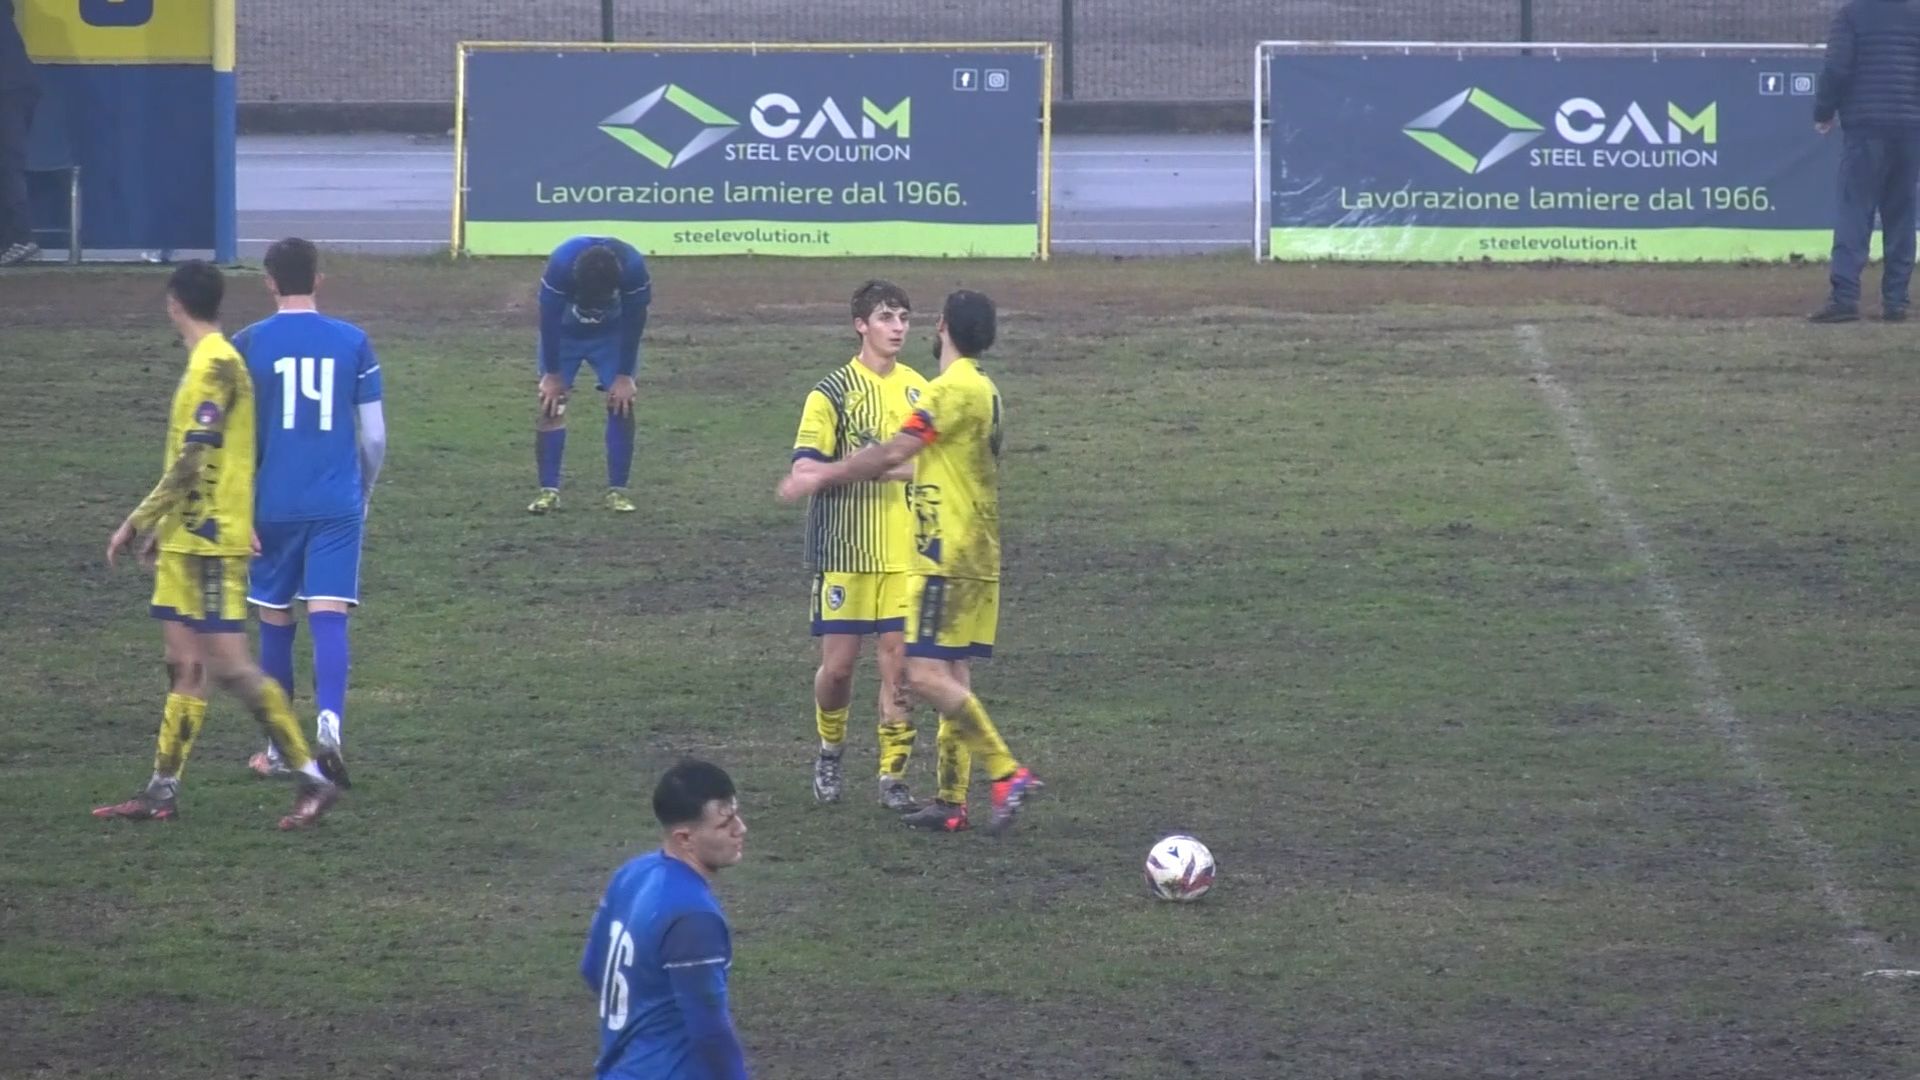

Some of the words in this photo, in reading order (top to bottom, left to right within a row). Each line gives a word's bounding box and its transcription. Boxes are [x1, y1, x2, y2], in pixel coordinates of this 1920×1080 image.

[750, 92, 911, 139] CAM
[1555, 97, 1718, 144] CAM
[725, 143, 780, 161] STEEL
[788, 143, 911, 162] EVOLUTION
[1530, 148, 1586, 167] STEEL
[1594, 148, 1718, 168] EVOLUTION
[536, 181, 714, 204] Lavorazione
[724, 181, 833, 204] lamiere
[843, 181, 886, 204] dal
[894, 181, 967, 206] 1966.
[1341, 187, 1519, 210] Lavorazione
[1530, 186, 1640, 211] lamiere
[1649, 186, 1694, 211] dal
[1702, 186, 1776, 211] 1966.
[674, 227, 830, 245] steelevolution.it
[1479, 235, 1637, 252] steelevolution.it
[274, 356, 335, 431] 14
[599, 920, 635, 1031] 16
